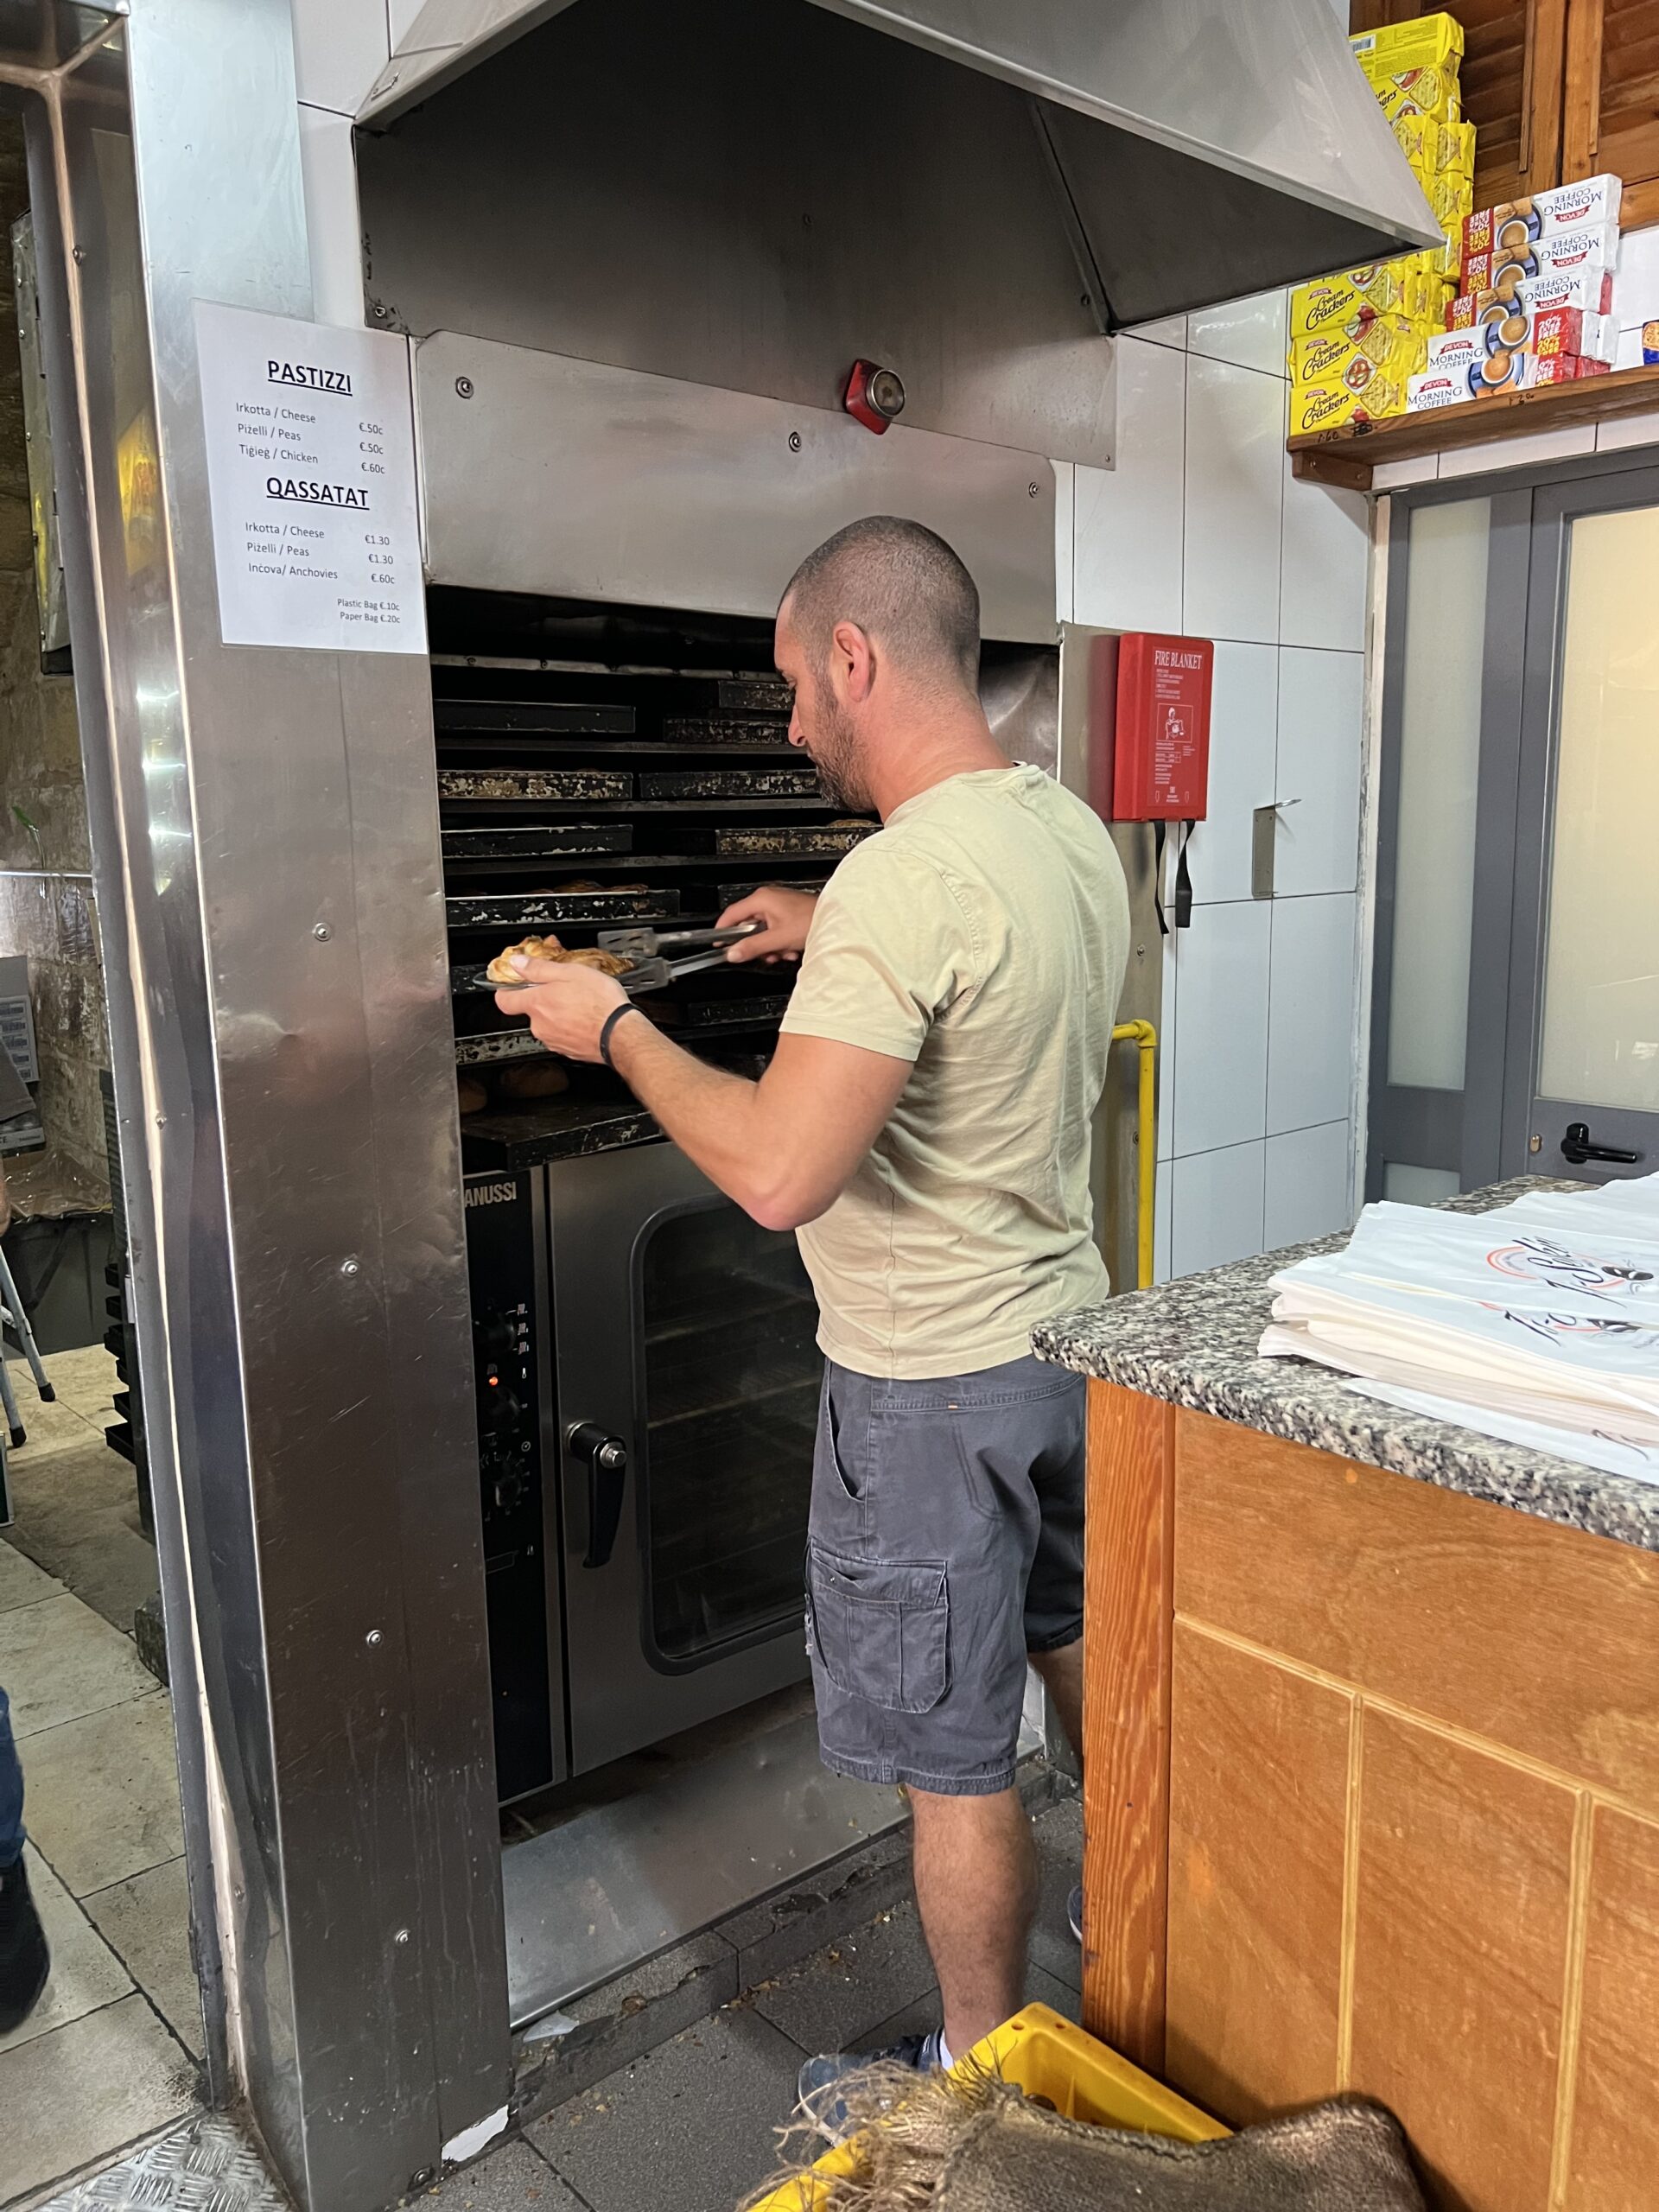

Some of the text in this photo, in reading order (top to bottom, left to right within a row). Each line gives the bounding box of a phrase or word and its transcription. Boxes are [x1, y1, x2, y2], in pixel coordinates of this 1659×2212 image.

[1544, 191, 1603, 217] MORNING
[1554, 188, 1592, 204] COFFEE
[1560, 208, 1586, 221] DEVON
[1541, 238, 1599, 261] MORNING
[1551, 234, 1588, 249] COFFEE
[1557, 254, 1583, 267] DEVON
[1525, 279, 1581, 303] MORNING
[1534, 276, 1570, 290] COFFEE
[1306, 290, 1355, 330] Crackers
[1317, 289, 1344, 311] Cream
[1540, 296, 1565, 308] DEVON
[1538, 315, 1561, 327] 20%
[1314, 340, 1340, 362] Cream
[1444, 341, 1469, 351] DEVON
[1303, 343, 1351, 380] Crackers
[1429, 347, 1484, 367] MORNING
[268, 359, 352, 394] PASTIZZI
[1424, 379, 1447, 390] DEVON
[1313, 391, 1339, 411] Cream
[1408, 386, 1462, 405] MORNING
[1417, 397, 1452, 410] COFFEE
[236, 402, 271, 416] Irkotta
[274, 407, 278, 419] /
[281, 409, 316, 423] Cheese
[1302, 393, 1350, 429] Crackers
[270, 426, 275, 439] /
[278, 429, 302, 442] Peas
[273, 448, 277, 460] /
[280, 449, 319, 464] Chicken
[266, 476, 369, 508] QASSATAT
[245, 522, 390, 546] Irkotta / Cheese €1.30
[279, 543, 284, 556] /
[287, 545, 309, 556] Peas
[368, 553, 394, 565] €1.30
[289, 566, 339, 580] Anchovies
[337, 598, 362, 608] Plastic
[364, 601, 378, 611] Bag
[340, 611, 363, 622] Paper
[364, 613, 378, 624] Bag
[1154, 650, 1203, 671] FIRE BLANKET
[464, 1181, 517, 1208] ANUSSI
